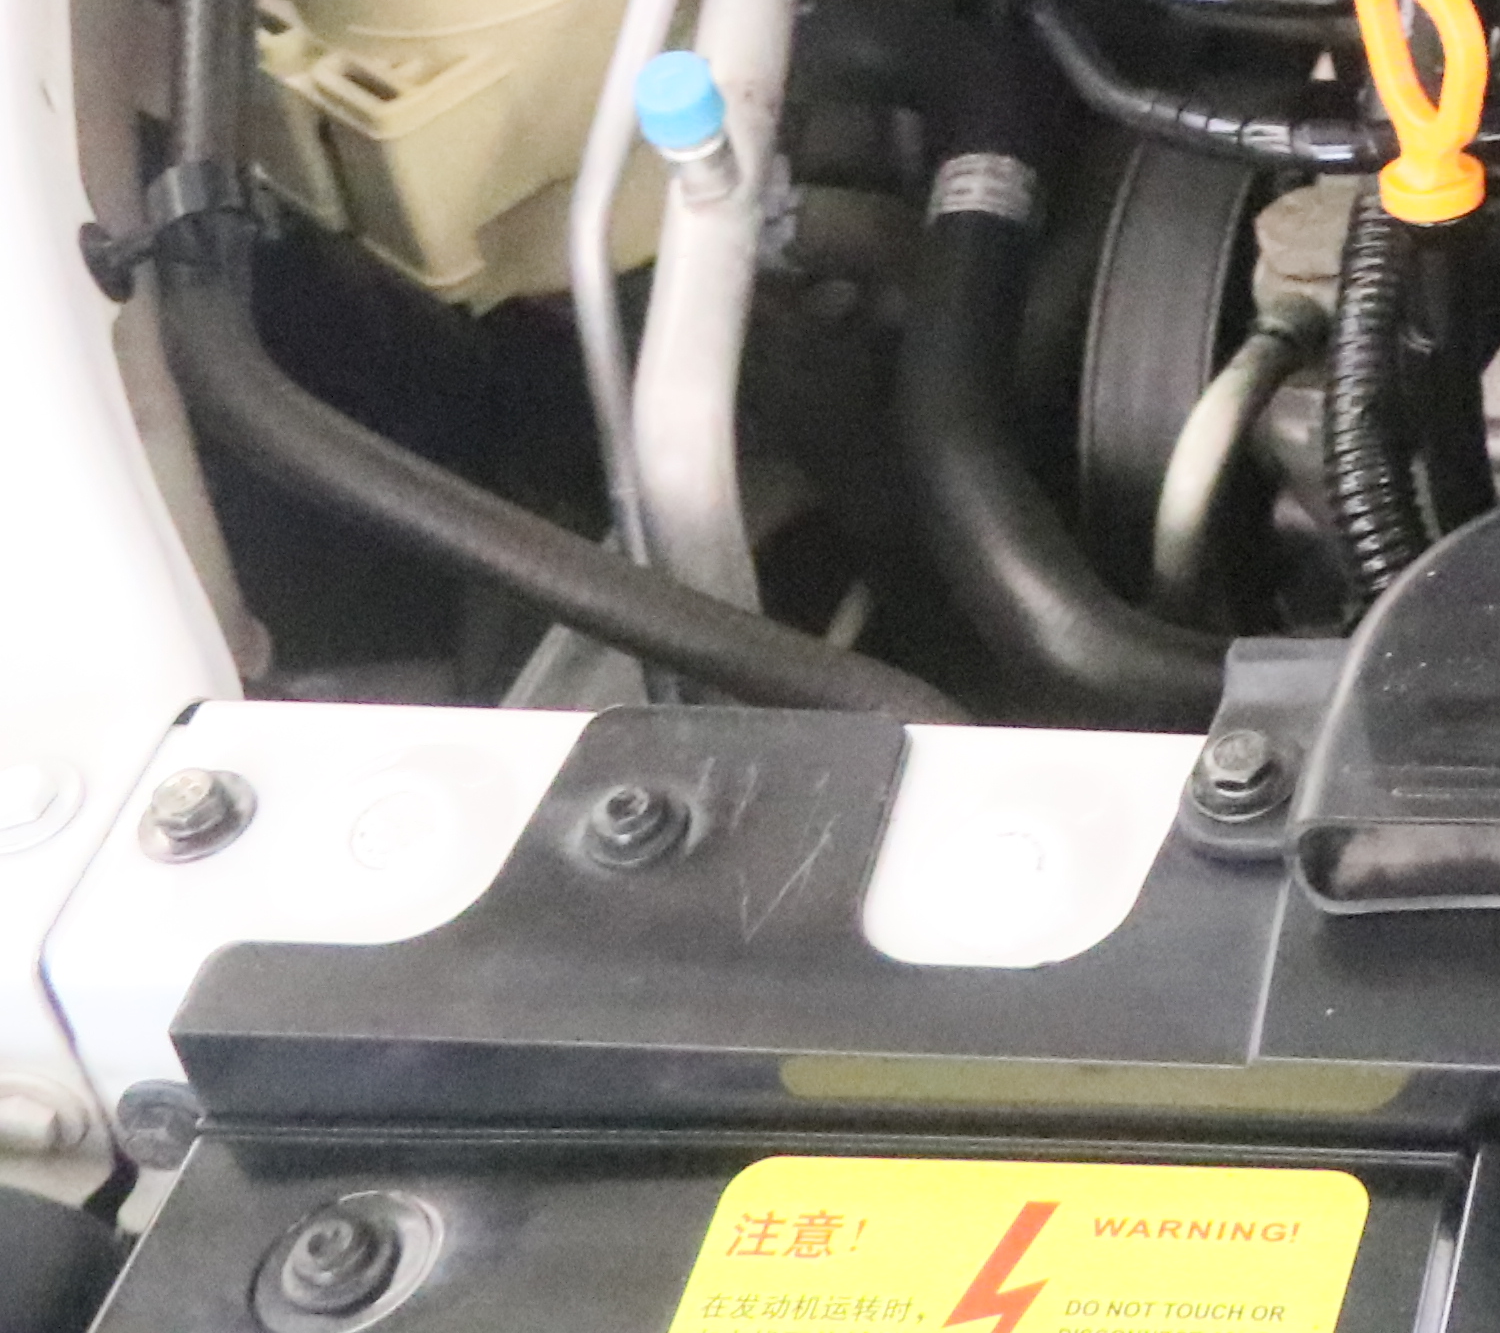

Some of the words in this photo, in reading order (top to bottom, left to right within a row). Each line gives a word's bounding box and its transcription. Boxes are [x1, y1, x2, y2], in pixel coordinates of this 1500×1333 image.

[1093, 1217, 1301, 1243] WARNING!
[1064, 1299, 1100, 1317] DO
[1106, 1300, 1155, 1318] NOT
[1163, 1302, 1244, 1322] TOUCH
[1250, 1305, 1287, 1323] OR
